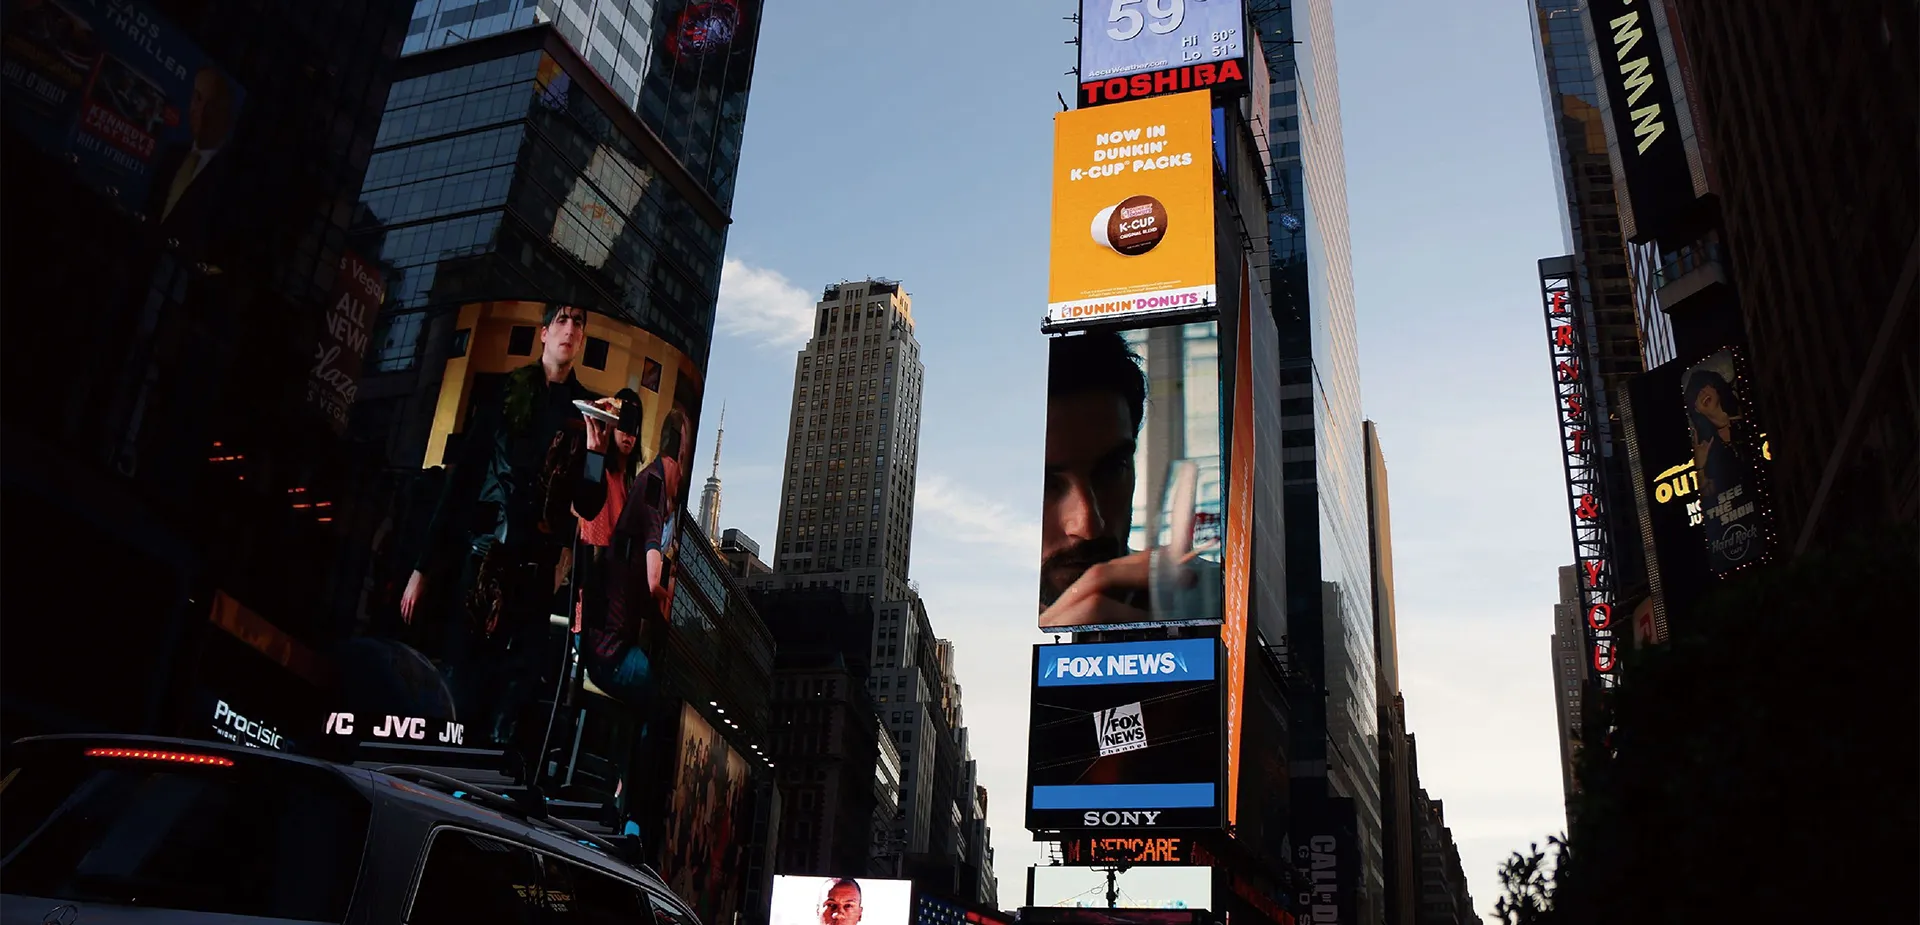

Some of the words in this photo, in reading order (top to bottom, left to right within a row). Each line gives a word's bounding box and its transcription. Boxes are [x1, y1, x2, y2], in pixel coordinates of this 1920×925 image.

[1107, 0, 1206, 41] 59
[105, 4, 187, 81] THRILLER
[1182, 34, 1199, 48] Hi
[1183, 51, 1202, 62] Lo
[1081, 59, 1243, 104] TOSHIBA
[1096, 128, 1141, 146] NOW
[1146, 124, 1165, 139] IN
[1093, 140, 1168, 162] DUNKIN'
[1133, 153, 1192, 173] PACKS
[1119, 216, 1155, 233] K-CUP
[336, 292, 365, 329] ALL
[1552, 290, 1588, 454] ERNST
[1576, 493, 1599, 520] &
[1717, 484, 1743, 504] SEE
[1706, 501, 1732, 520] THE
[1712, 533, 1735, 553] Hard
[1734, 524, 1758, 545] Rock
[1056, 656, 1104, 678] FOX
[1107, 652, 1176, 677] NEWS
[372, 715, 426, 741] JVC
[1111, 713, 1142, 731] FOX
[438, 721, 465, 746] JVC
[1105, 727, 1144, 746] NEWS
[1101, 742, 1146, 755] channel
[1083, 811, 1161, 827] SONY
[1091, 838, 1181, 862] MEDICARE
[1310, 834, 1338, 896] CALL
[1312, 904, 1339, 925] D
